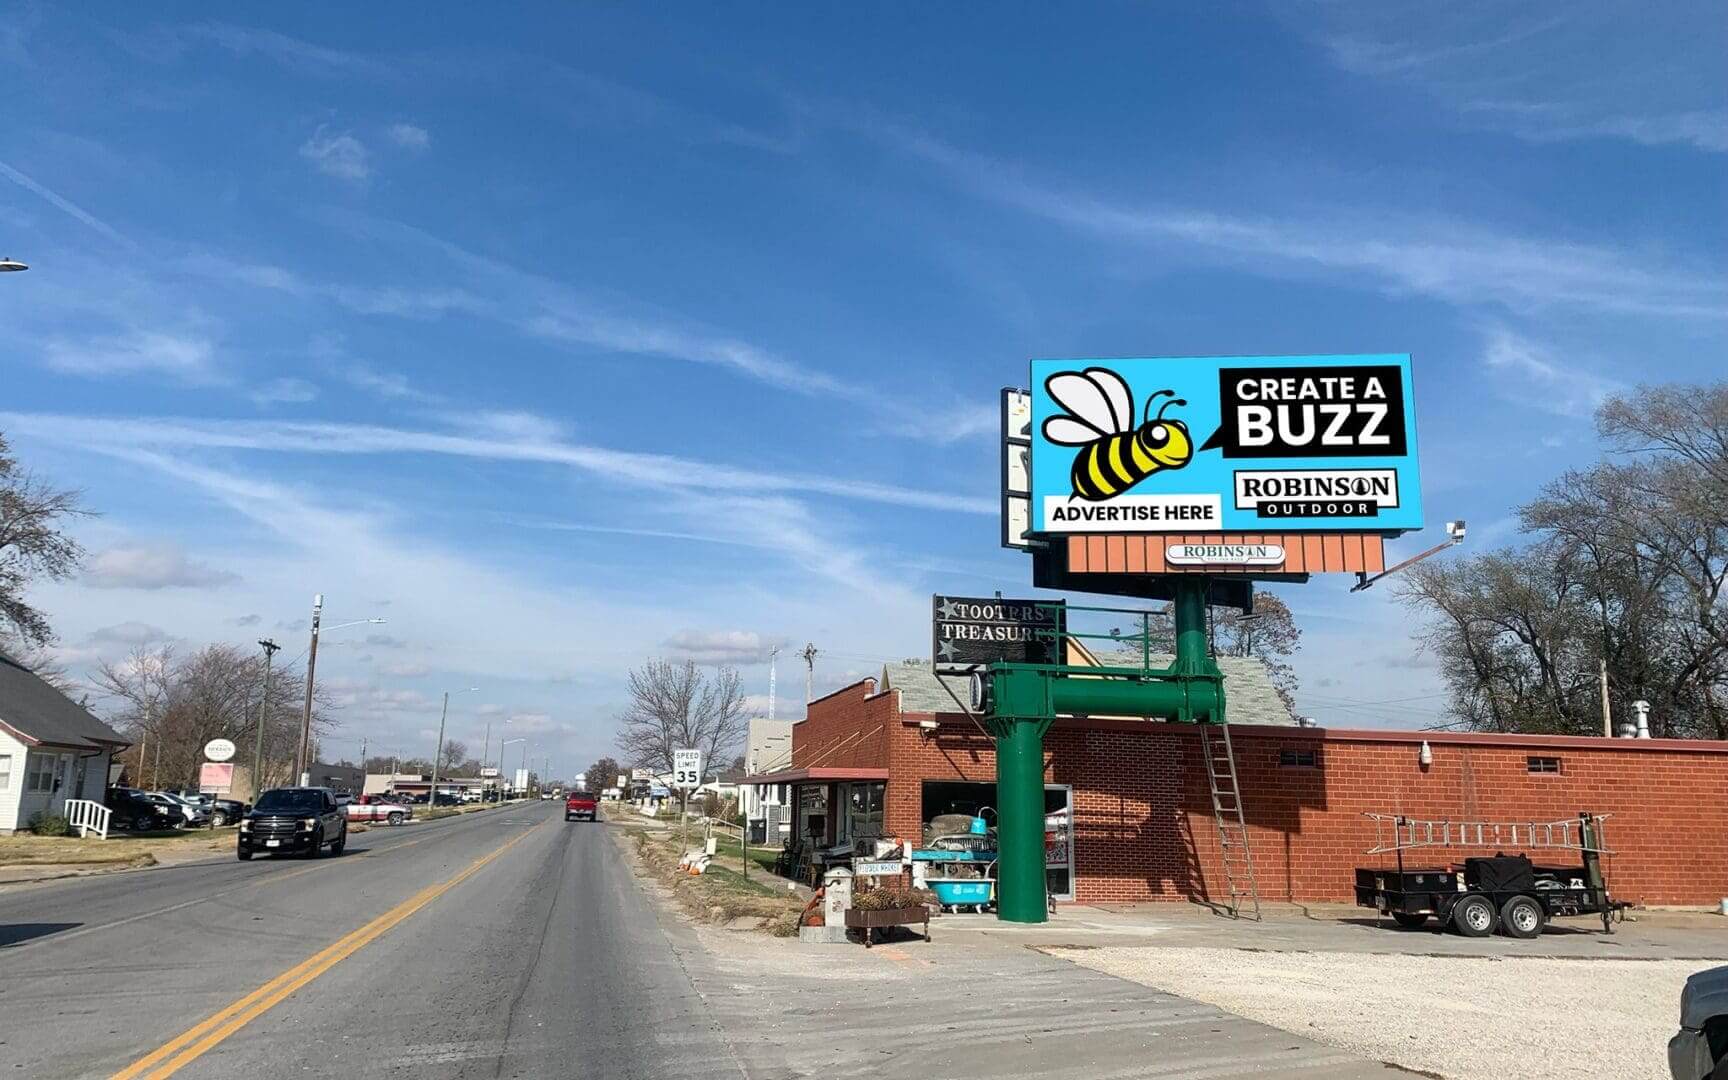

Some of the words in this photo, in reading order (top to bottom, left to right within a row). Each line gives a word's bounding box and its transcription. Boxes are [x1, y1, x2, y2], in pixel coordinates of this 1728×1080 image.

[1236, 377, 1354, 401] CREATE
[1364, 377, 1386, 399] A
[1237, 403, 1391, 447] BUZZ
[1243, 475, 1390, 497] ROBINSON
[1052, 505, 1160, 521] ADVERTISE
[1165, 504, 1214, 520] HERE
[1267, 503, 1369, 516] OUTDOOR
[1184, 546, 1266, 557] ROBINSN
[957, 604, 1045, 621] TOOTERS
[676, 752, 699, 760] SPEED
[677, 771, 697, 783] 35
